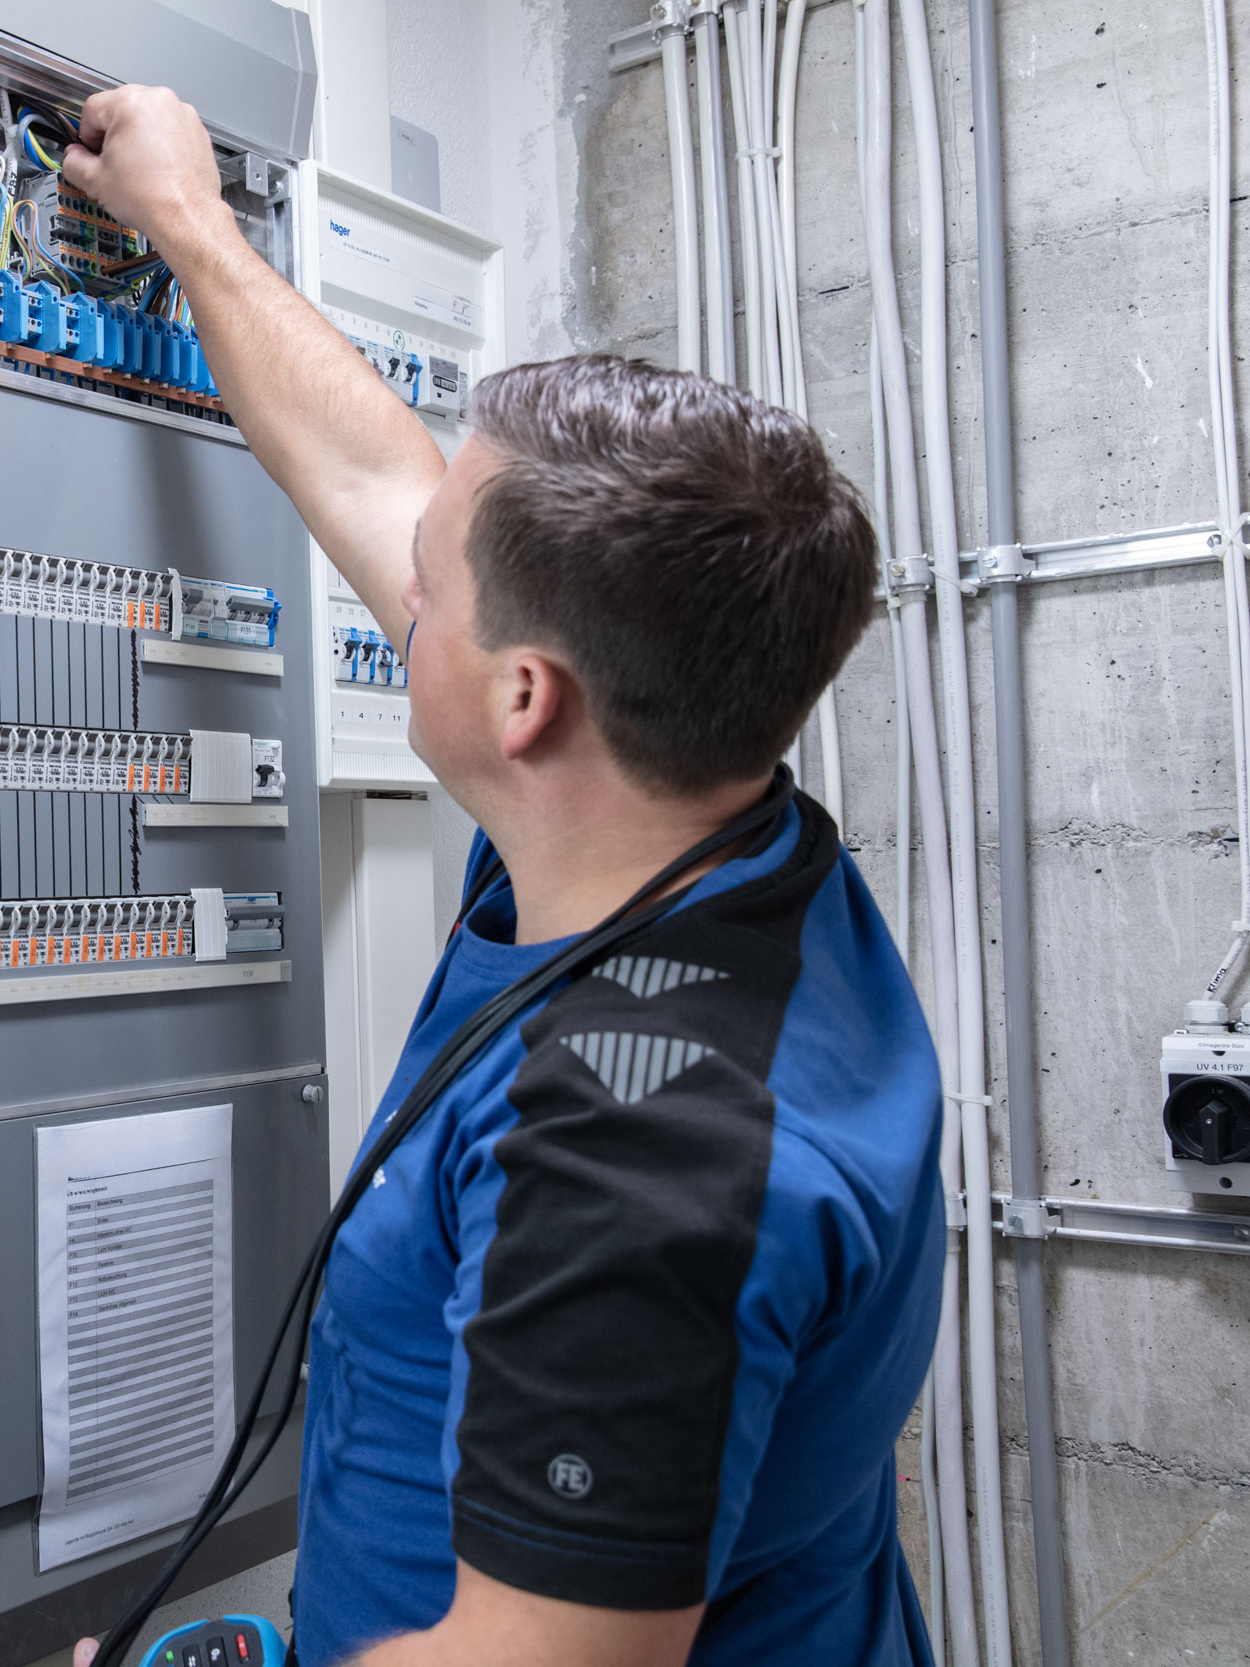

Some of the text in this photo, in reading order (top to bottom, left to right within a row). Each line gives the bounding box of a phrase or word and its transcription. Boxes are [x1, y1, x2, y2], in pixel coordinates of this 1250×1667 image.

[330, 219, 350, 237] hager
[1206, 967, 1228, 993] Klima
[1196, 1063, 1210, 1071] UV
[1227, 1064, 1244, 1072] F97
